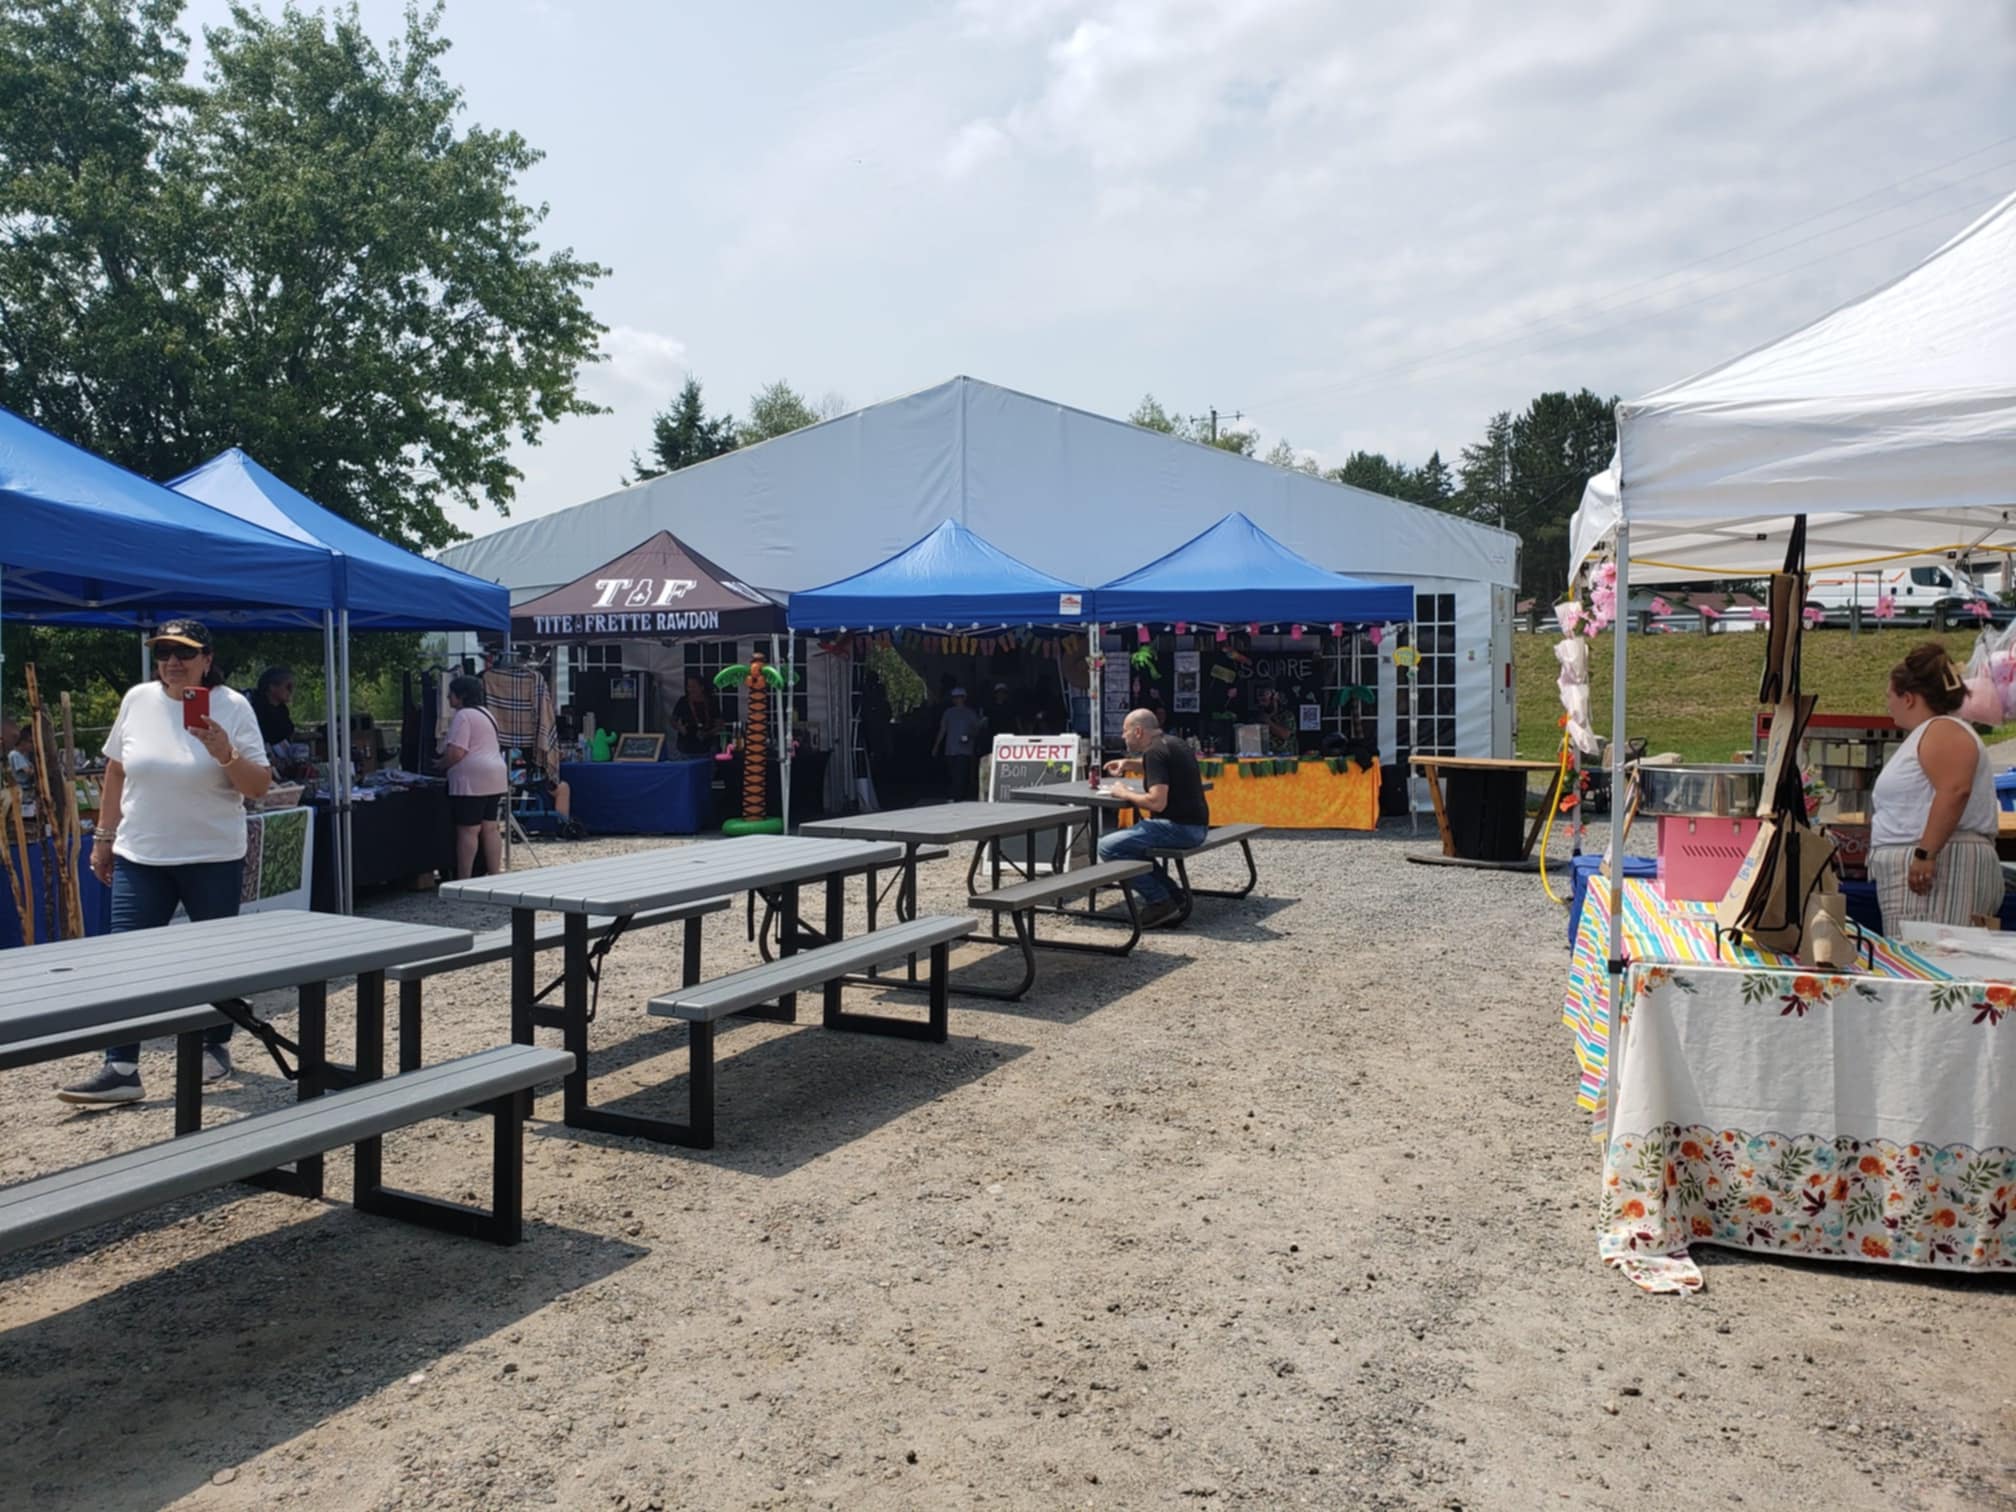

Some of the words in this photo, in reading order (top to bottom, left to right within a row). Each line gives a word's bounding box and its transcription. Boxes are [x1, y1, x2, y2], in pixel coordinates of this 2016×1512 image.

[534, 615, 573, 634] TITE
[585, 613, 651, 633] FRETTE
[657, 611, 719, 631] RAWDON
[1238, 658, 1313, 680] SQUARE
[999, 745, 1072, 759] OUVERT
